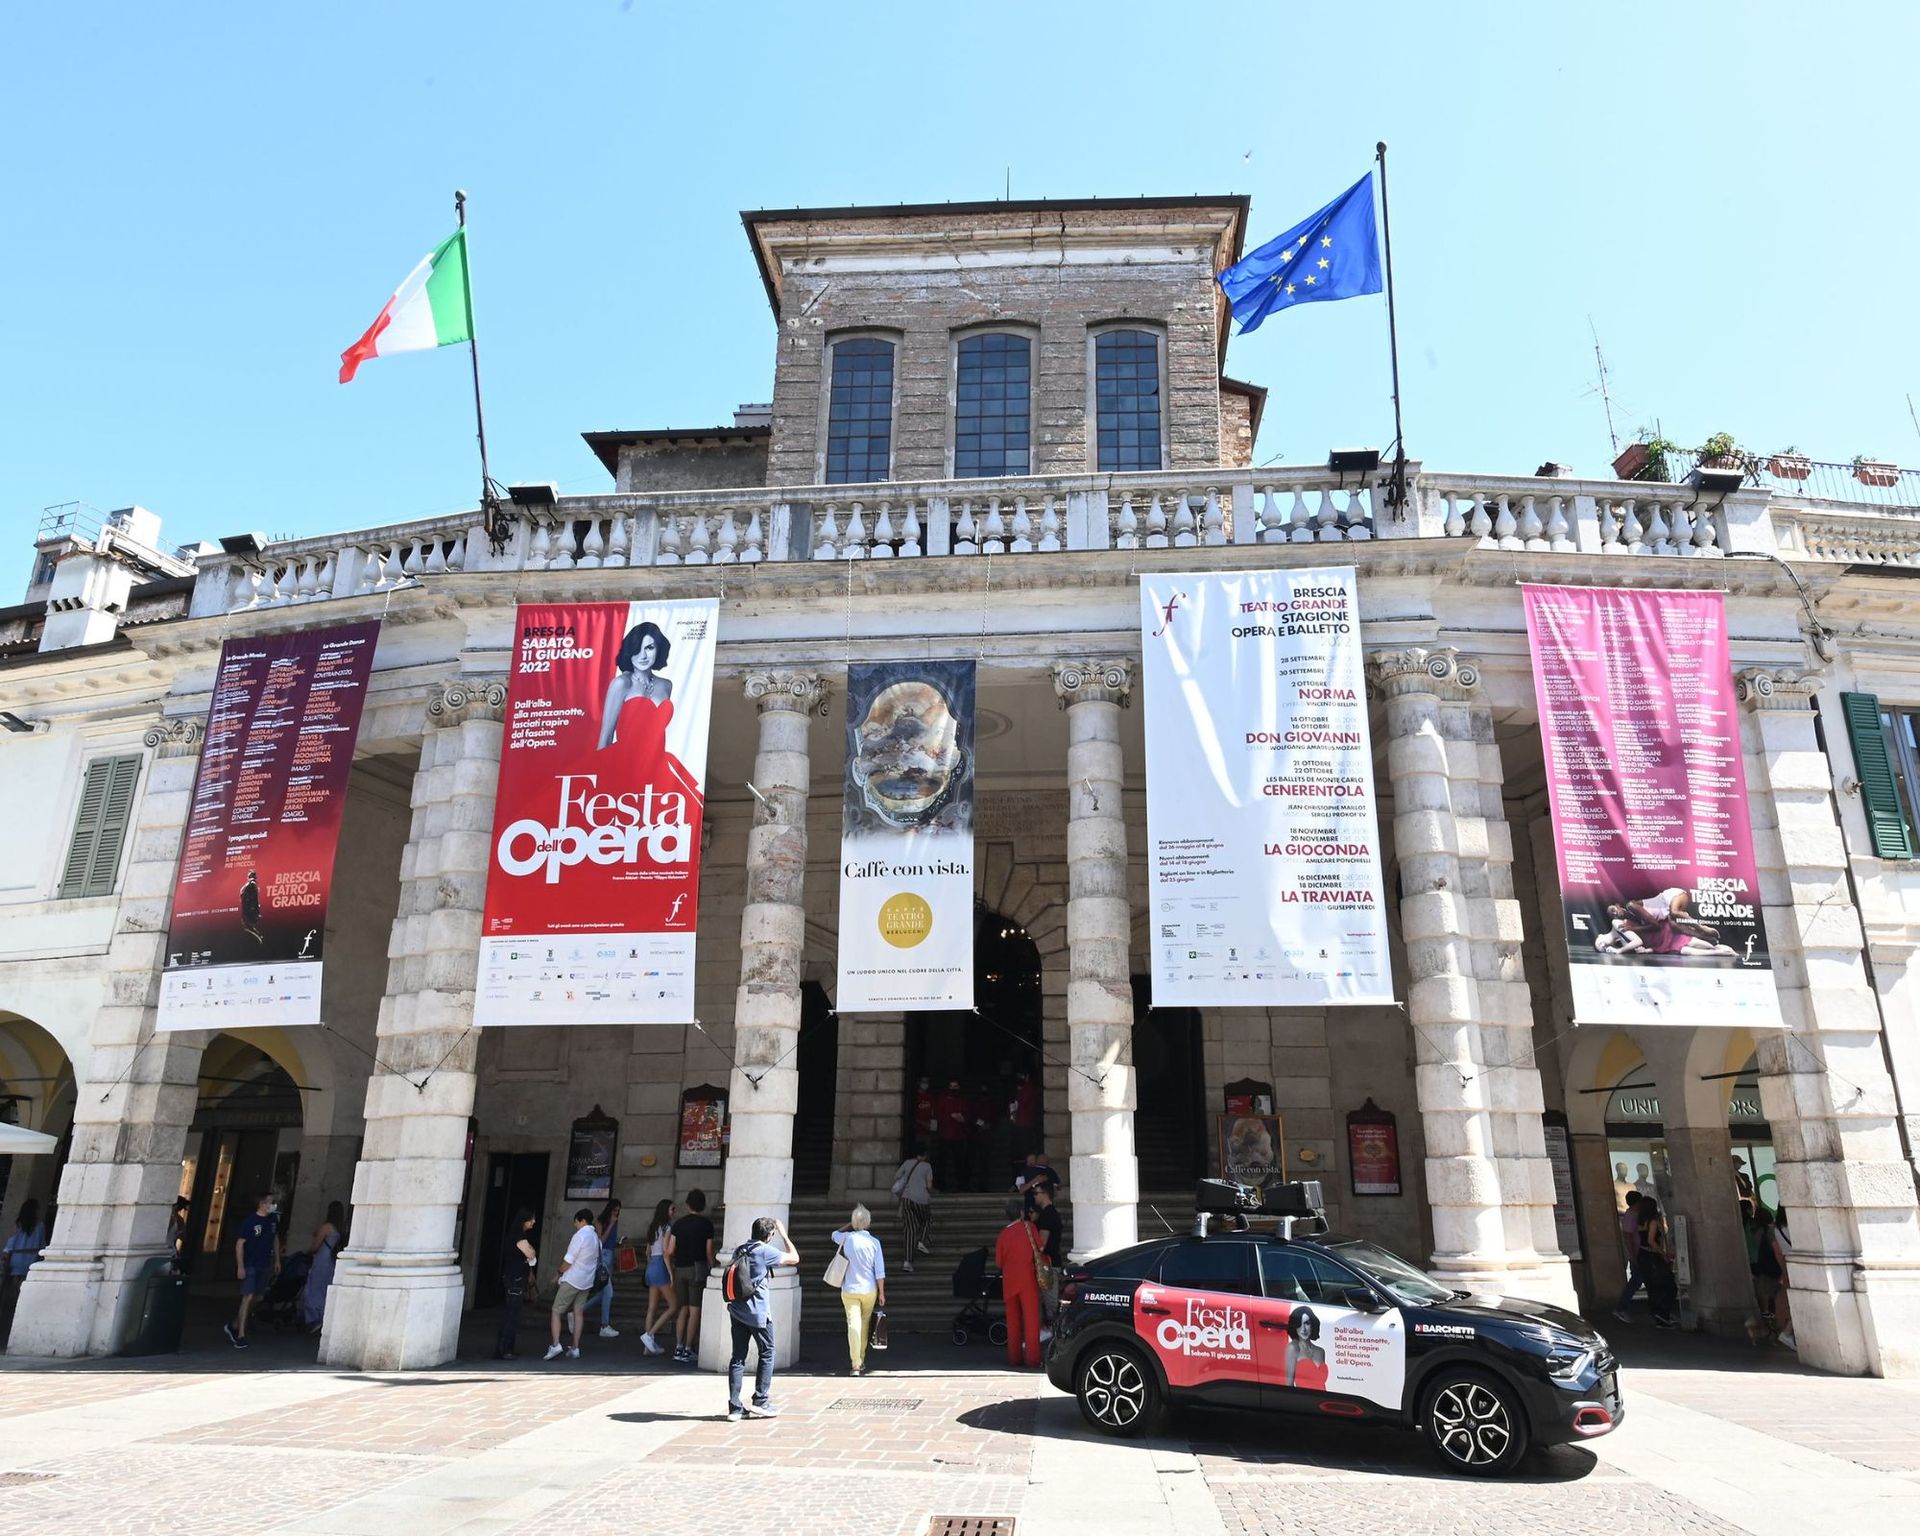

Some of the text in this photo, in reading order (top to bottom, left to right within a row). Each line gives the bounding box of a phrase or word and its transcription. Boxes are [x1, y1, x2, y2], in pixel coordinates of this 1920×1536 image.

[1294, 588, 1347, 598] BRESCIA
[1240, 600, 1348, 613] TEATRO GRANDE
[1282, 612, 1349, 624] STAGIONE
[524, 626, 576, 638] BRESCIA
[1232, 624, 1350, 638] OPERA E BALLETTO
[522, 637, 574, 648] SABATO
[522, 648, 594, 660] 11 GIUGNO
[519, 662, 550, 674] 2022
[1298, 688, 1356, 700] NORMA
[515, 699, 552, 709] Dall'alba
[514, 708, 586, 719] alla mezzanotte,
[512, 718, 569, 729] lasciati rapire
[512, 728, 555, 739] dal fascino
[1246, 732, 1360, 744] DON GIOVANNI
[510, 738, 557, 750] dell'Opera.
[1263, 784, 1364, 797] CENERENTOLA
[555, 774, 690, 829] Festa
[232, 806, 258, 814] CONCERTO
[498, 820, 692, 884] Opera
[537, 840, 562, 852] dell'
[1264, 844, 1369, 856] LA GIOCONDA
[845, 859, 970, 878] Caffè con vista.
[276, 870, 320, 884] BRESCIA
[266, 883, 308, 897] TEATRO
[1697, 877, 1748, 892] BRESCIA
[272, 894, 320, 908] GRANDE
[1281, 890, 1373, 902] LA TRAVIATA
[1690, 889, 1736, 904] TEATRO
[886, 912, 924, 920] TEATRO
[1698, 903, 1754, 918] GRANDE
[886, 921, 924, 929] GRANDE
[1090, 1293, 1130, 1303] BARCHETTI
[1185, 1298, 1246, 1329] Festa
[1422, 1324, 1475, 1335] BARCHETTI
[1157, 1319, 1250, 1356] Opera
[1217, 1352, 1236, 1360] giugno
